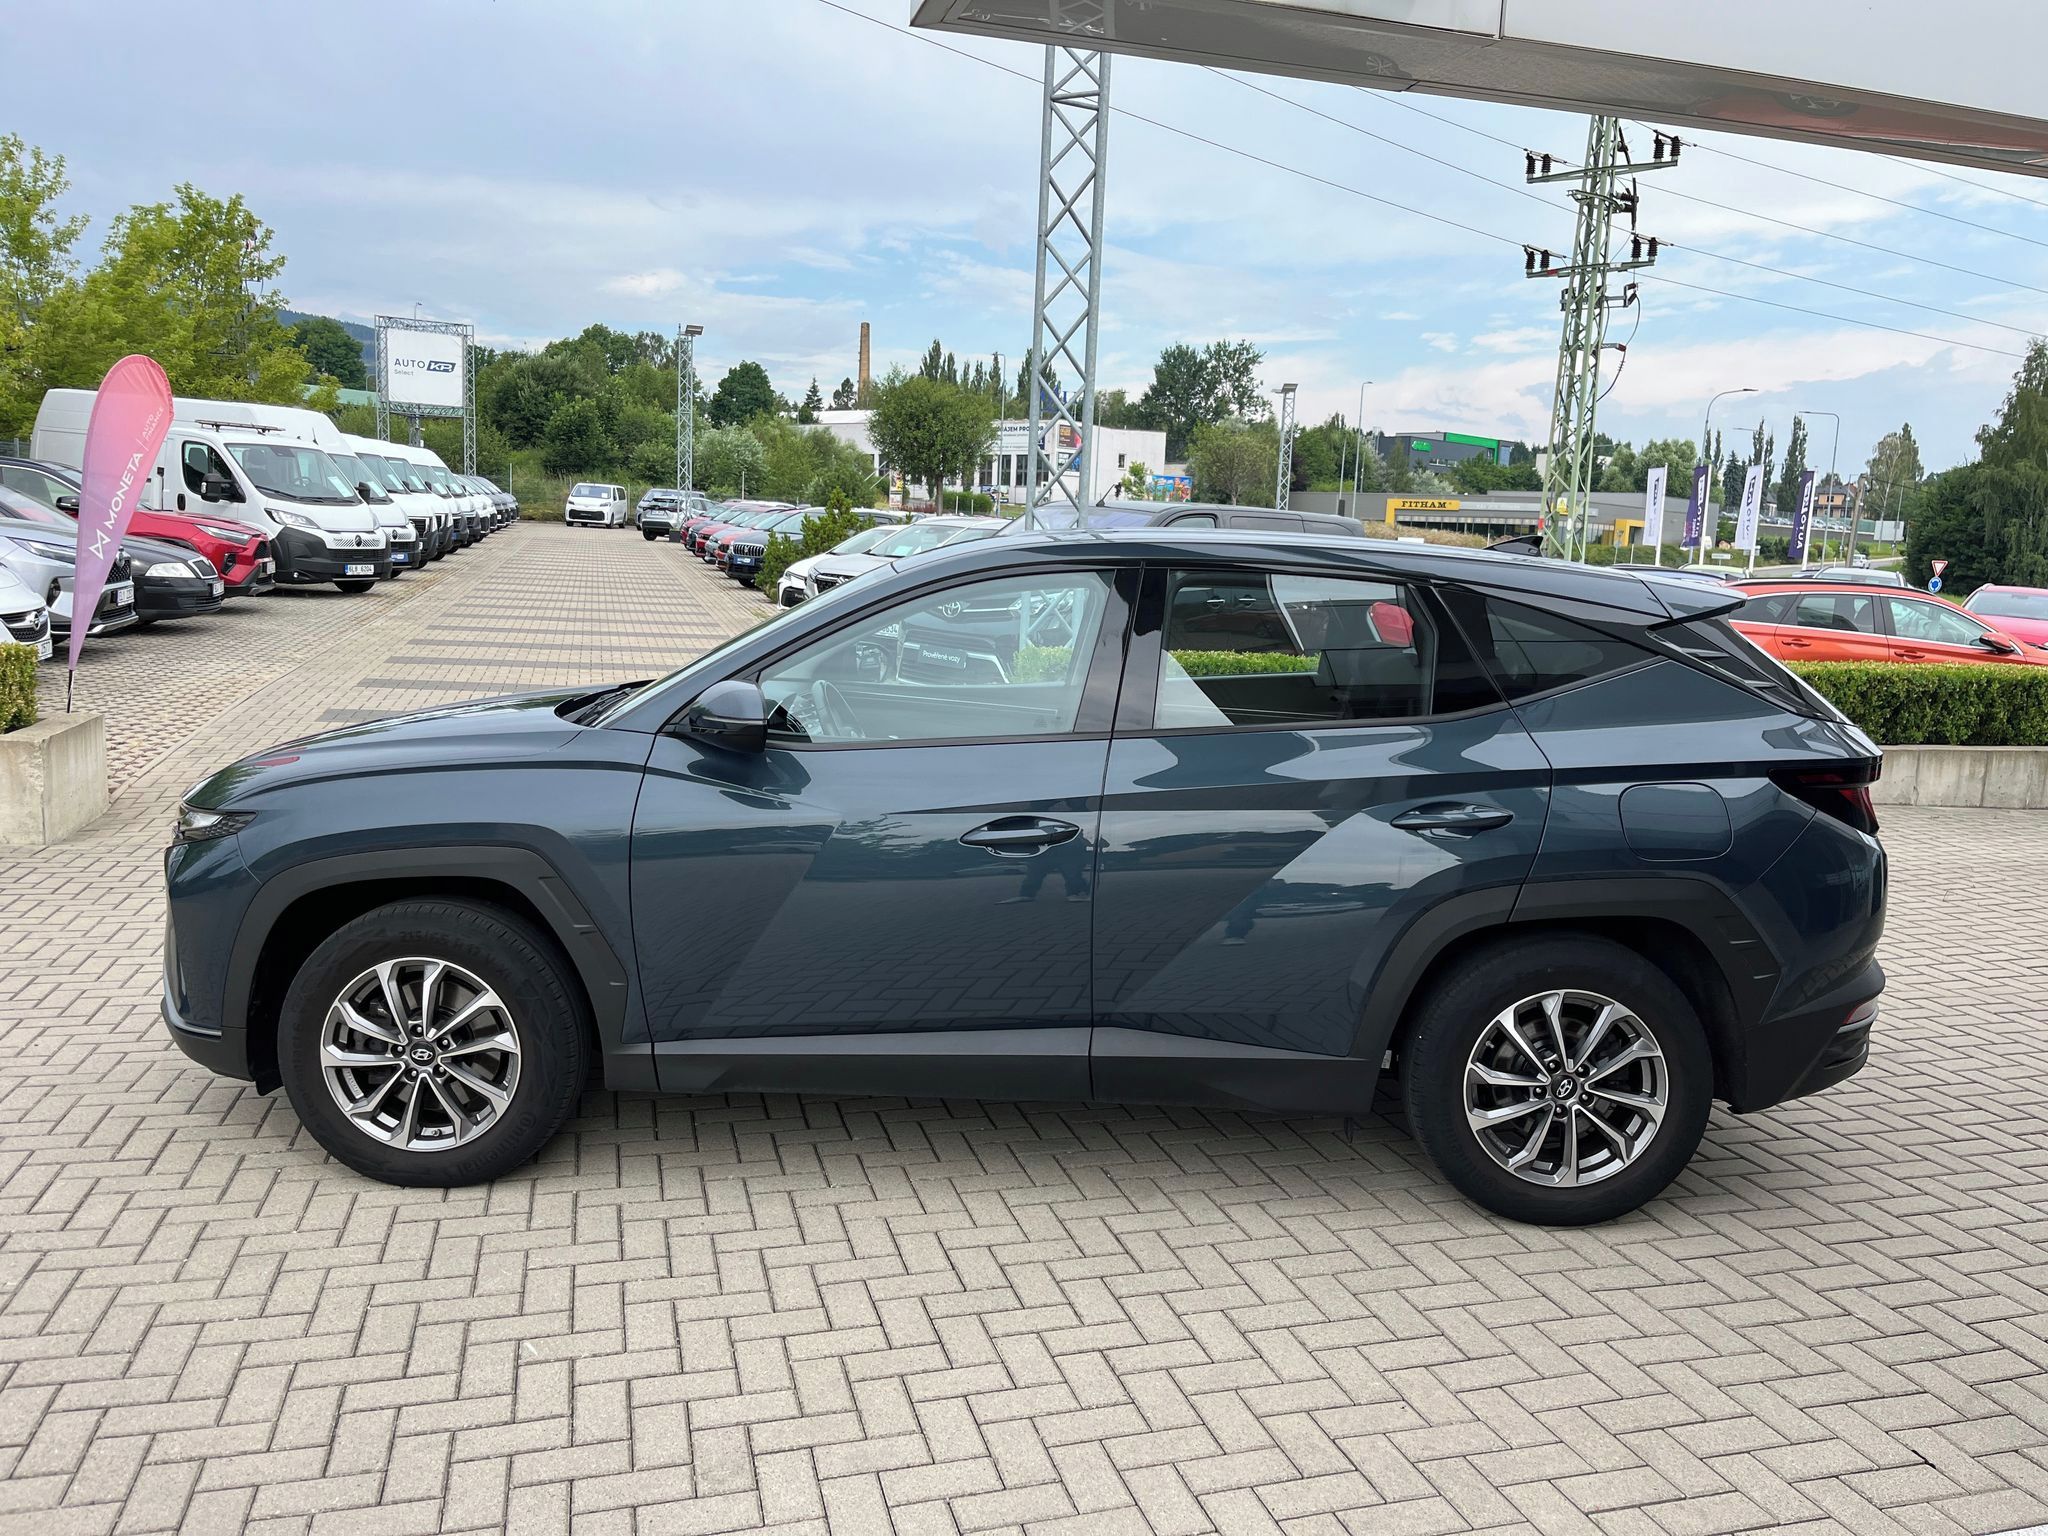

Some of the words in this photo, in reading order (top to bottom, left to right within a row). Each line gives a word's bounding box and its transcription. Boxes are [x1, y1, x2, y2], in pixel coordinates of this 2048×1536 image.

[394, 358, 425, 369] AUTO
[141, 413, 155, 439] AUTO
[145, 407, 164, 442] FINANCE
[104, 453, 144, 530] MONETA
[1401, 500, 1447, 509] FITHAM
[948, 655, 960, 664] vozy
[456, 1111, 537, 1177] Continental
